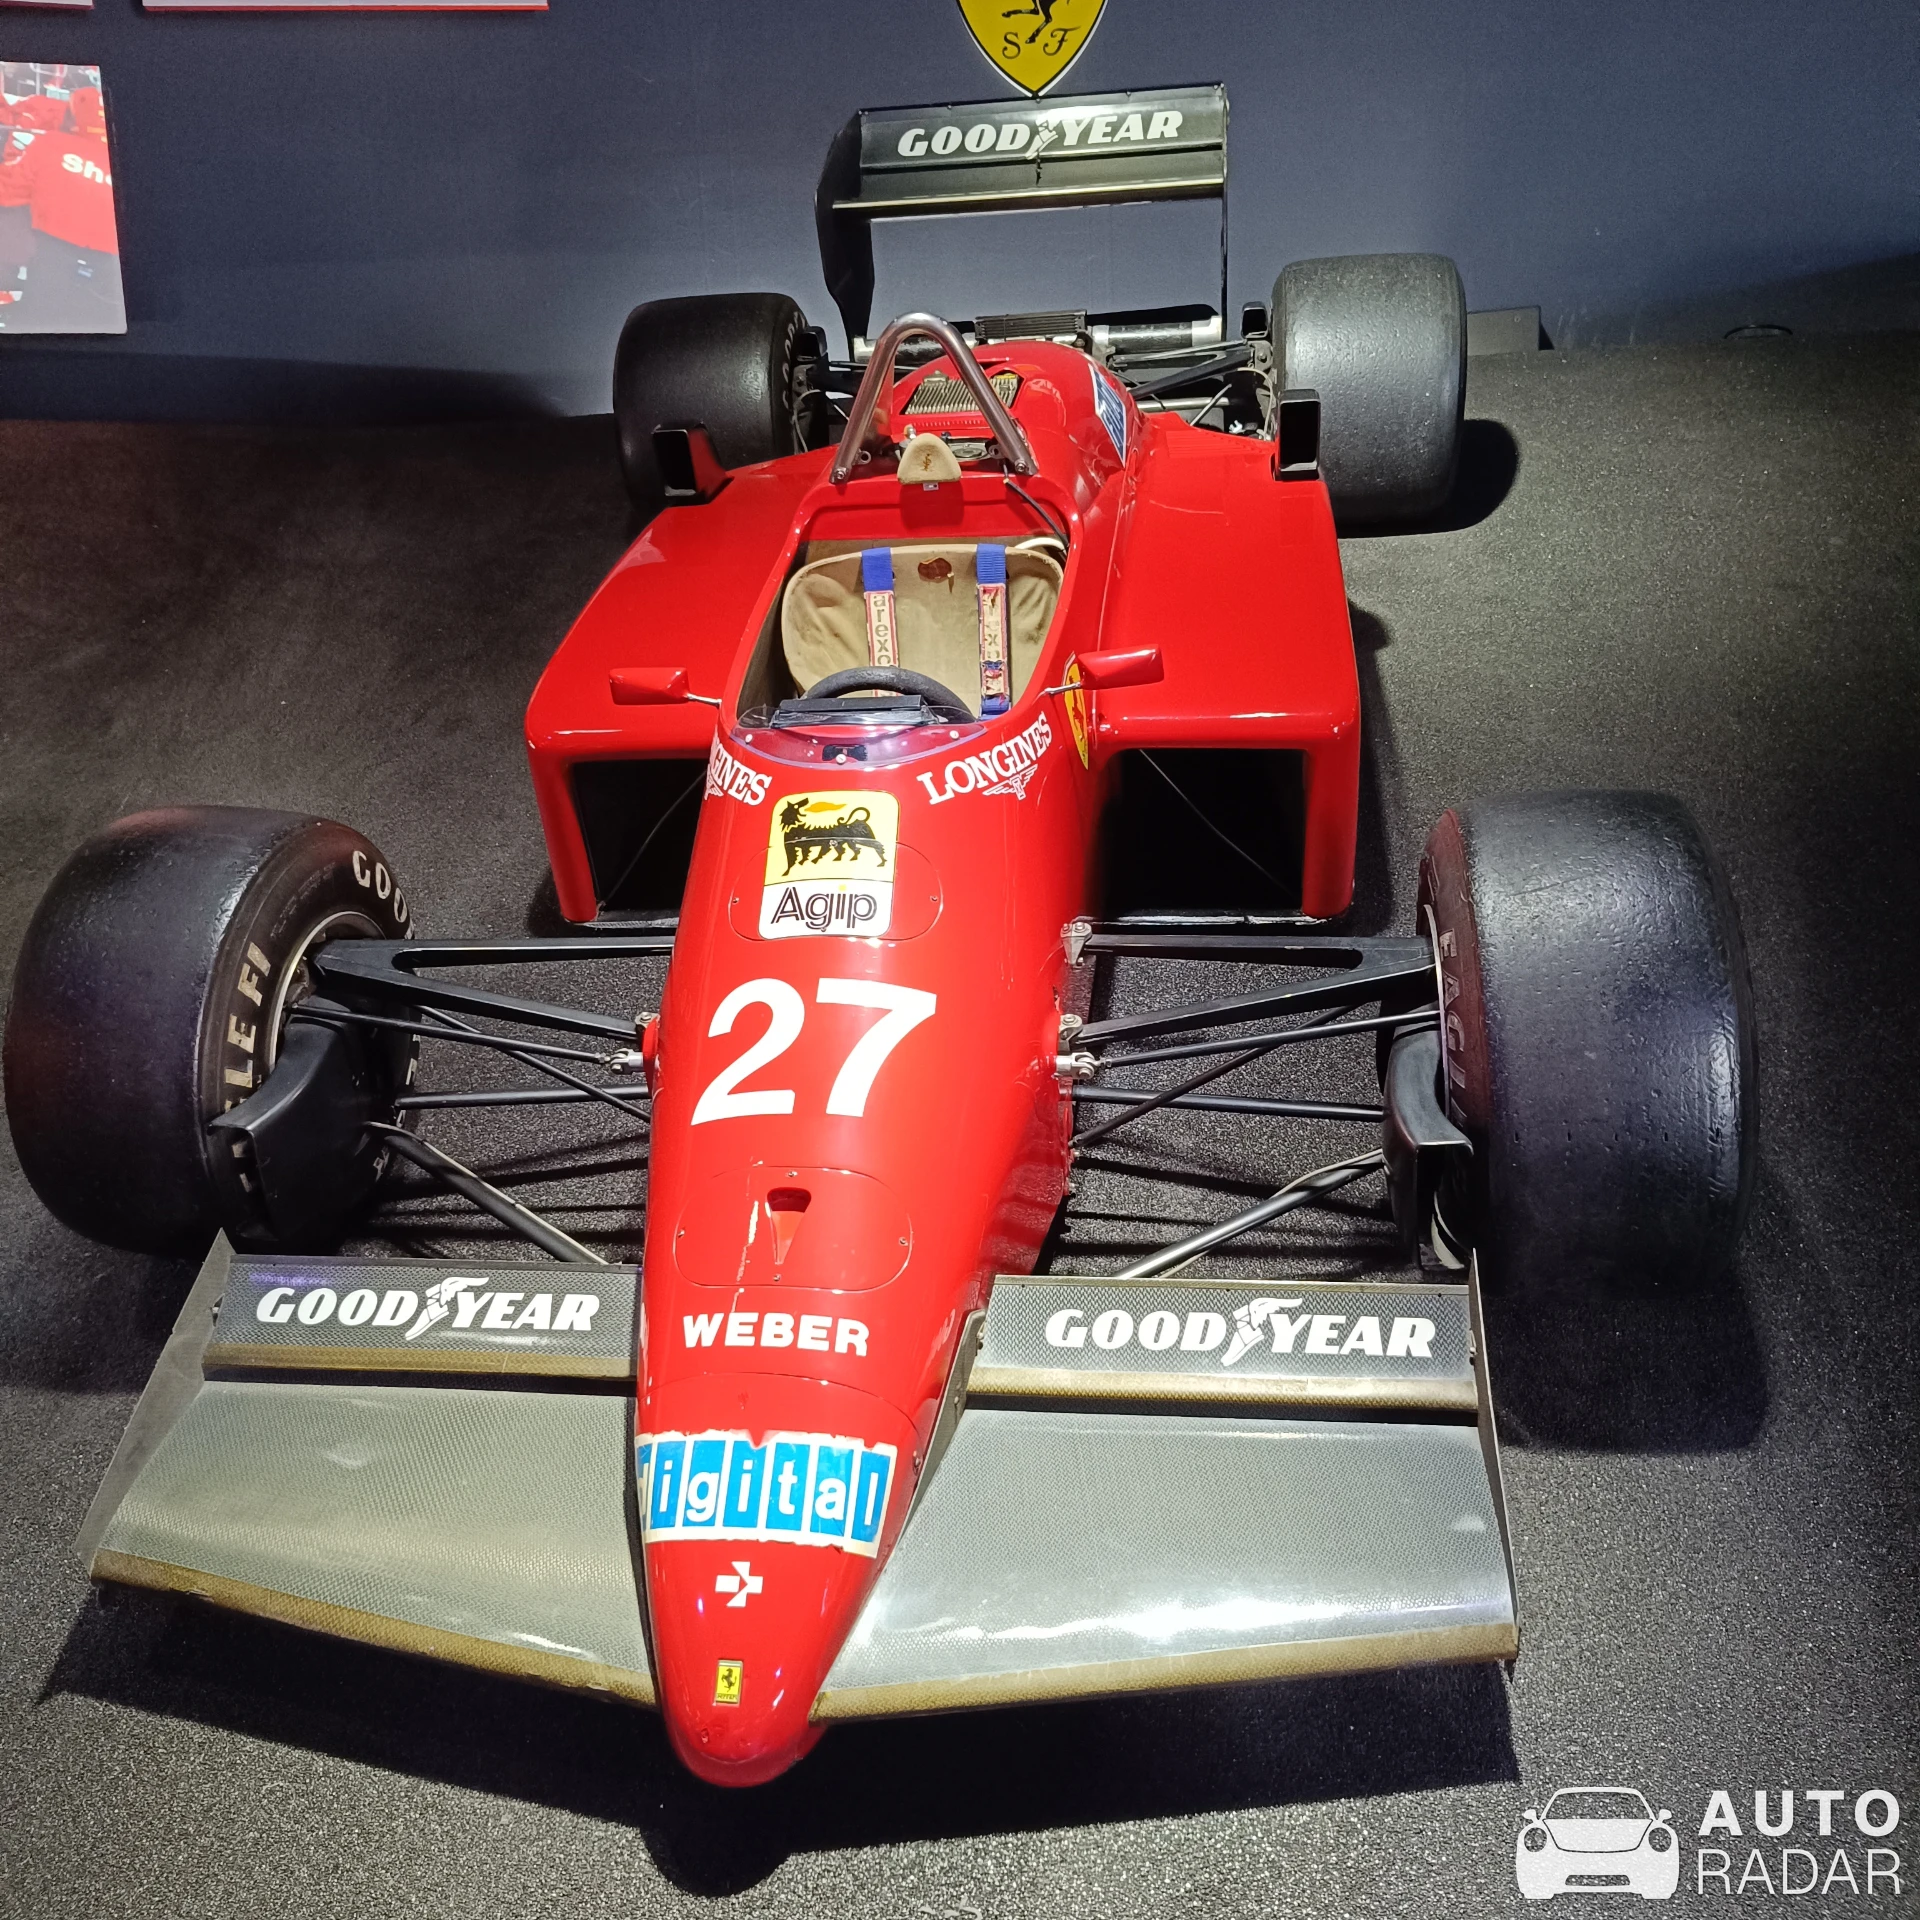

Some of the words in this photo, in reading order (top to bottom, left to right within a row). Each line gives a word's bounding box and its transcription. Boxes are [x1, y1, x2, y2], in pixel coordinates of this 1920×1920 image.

[1001, 31, 1022, 60] S
[1042, 25, 1082, 56] F
[873, 593, 893, 667] arexo
[917, 711, 1053, 805] LONGINES
[770, 885, 878, 931] Agip
[691, 977, 938, 1126] 27
[683, 1312, 870, 1356] WEBER
